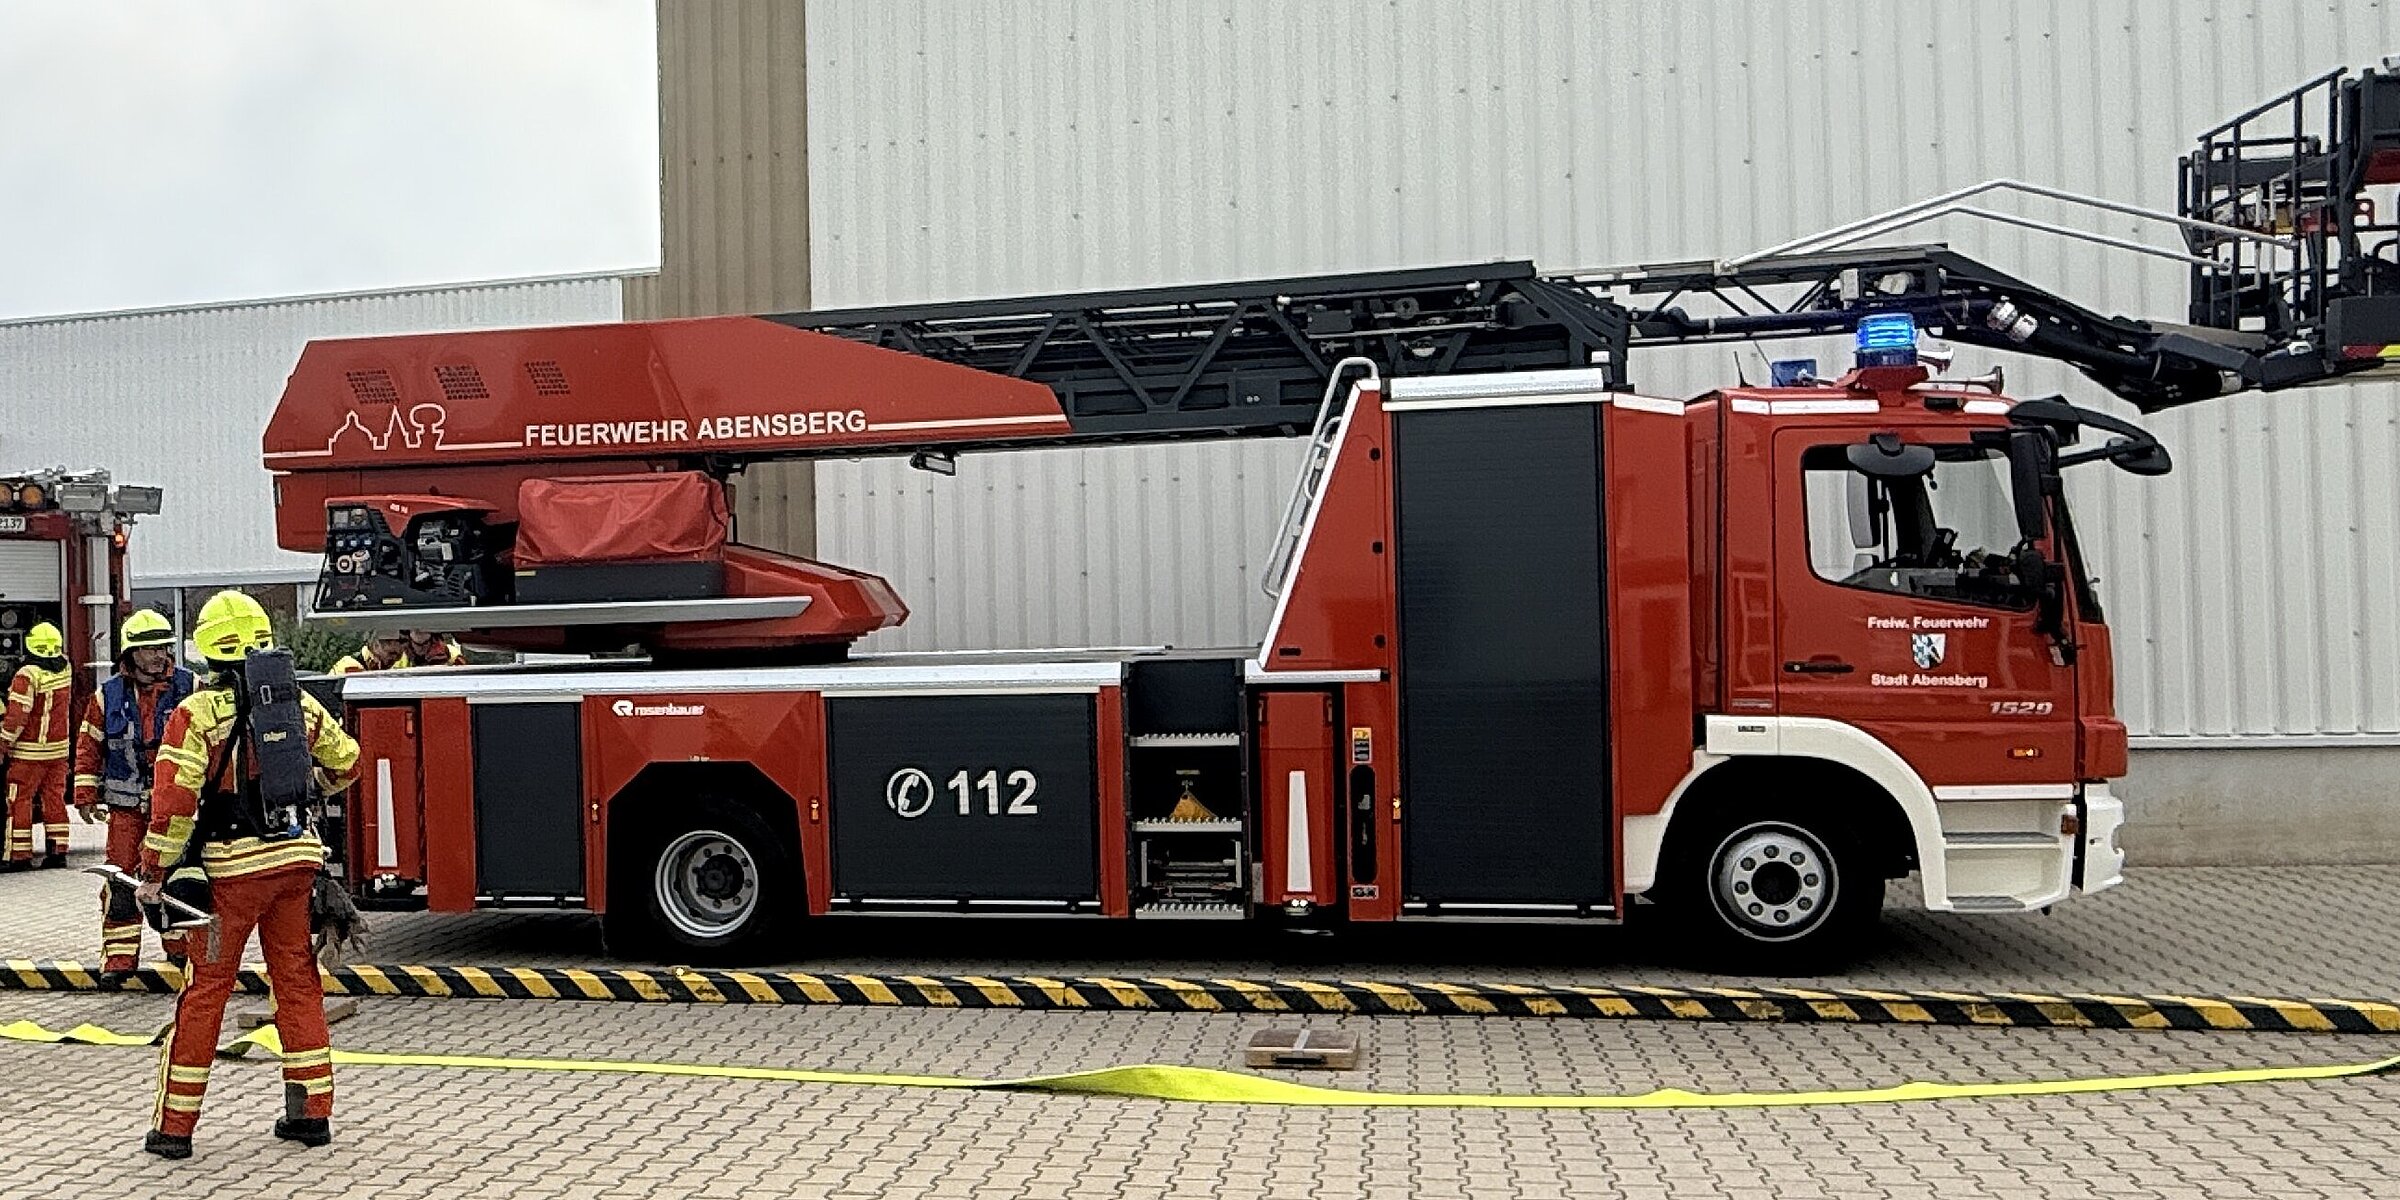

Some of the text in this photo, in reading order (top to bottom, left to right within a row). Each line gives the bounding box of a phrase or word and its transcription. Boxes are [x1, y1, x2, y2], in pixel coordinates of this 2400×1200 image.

[525, 409, 867, 447] FEUERWEHR ABENSBERG
[1867, 616, 1990, 629] Freiw. Feuerwehr
[1870, 673, 1988, 689] Stadt Abensberg
[1989, 701, 2054, 716] 1529
[947, 769, 1039, 816] 112
